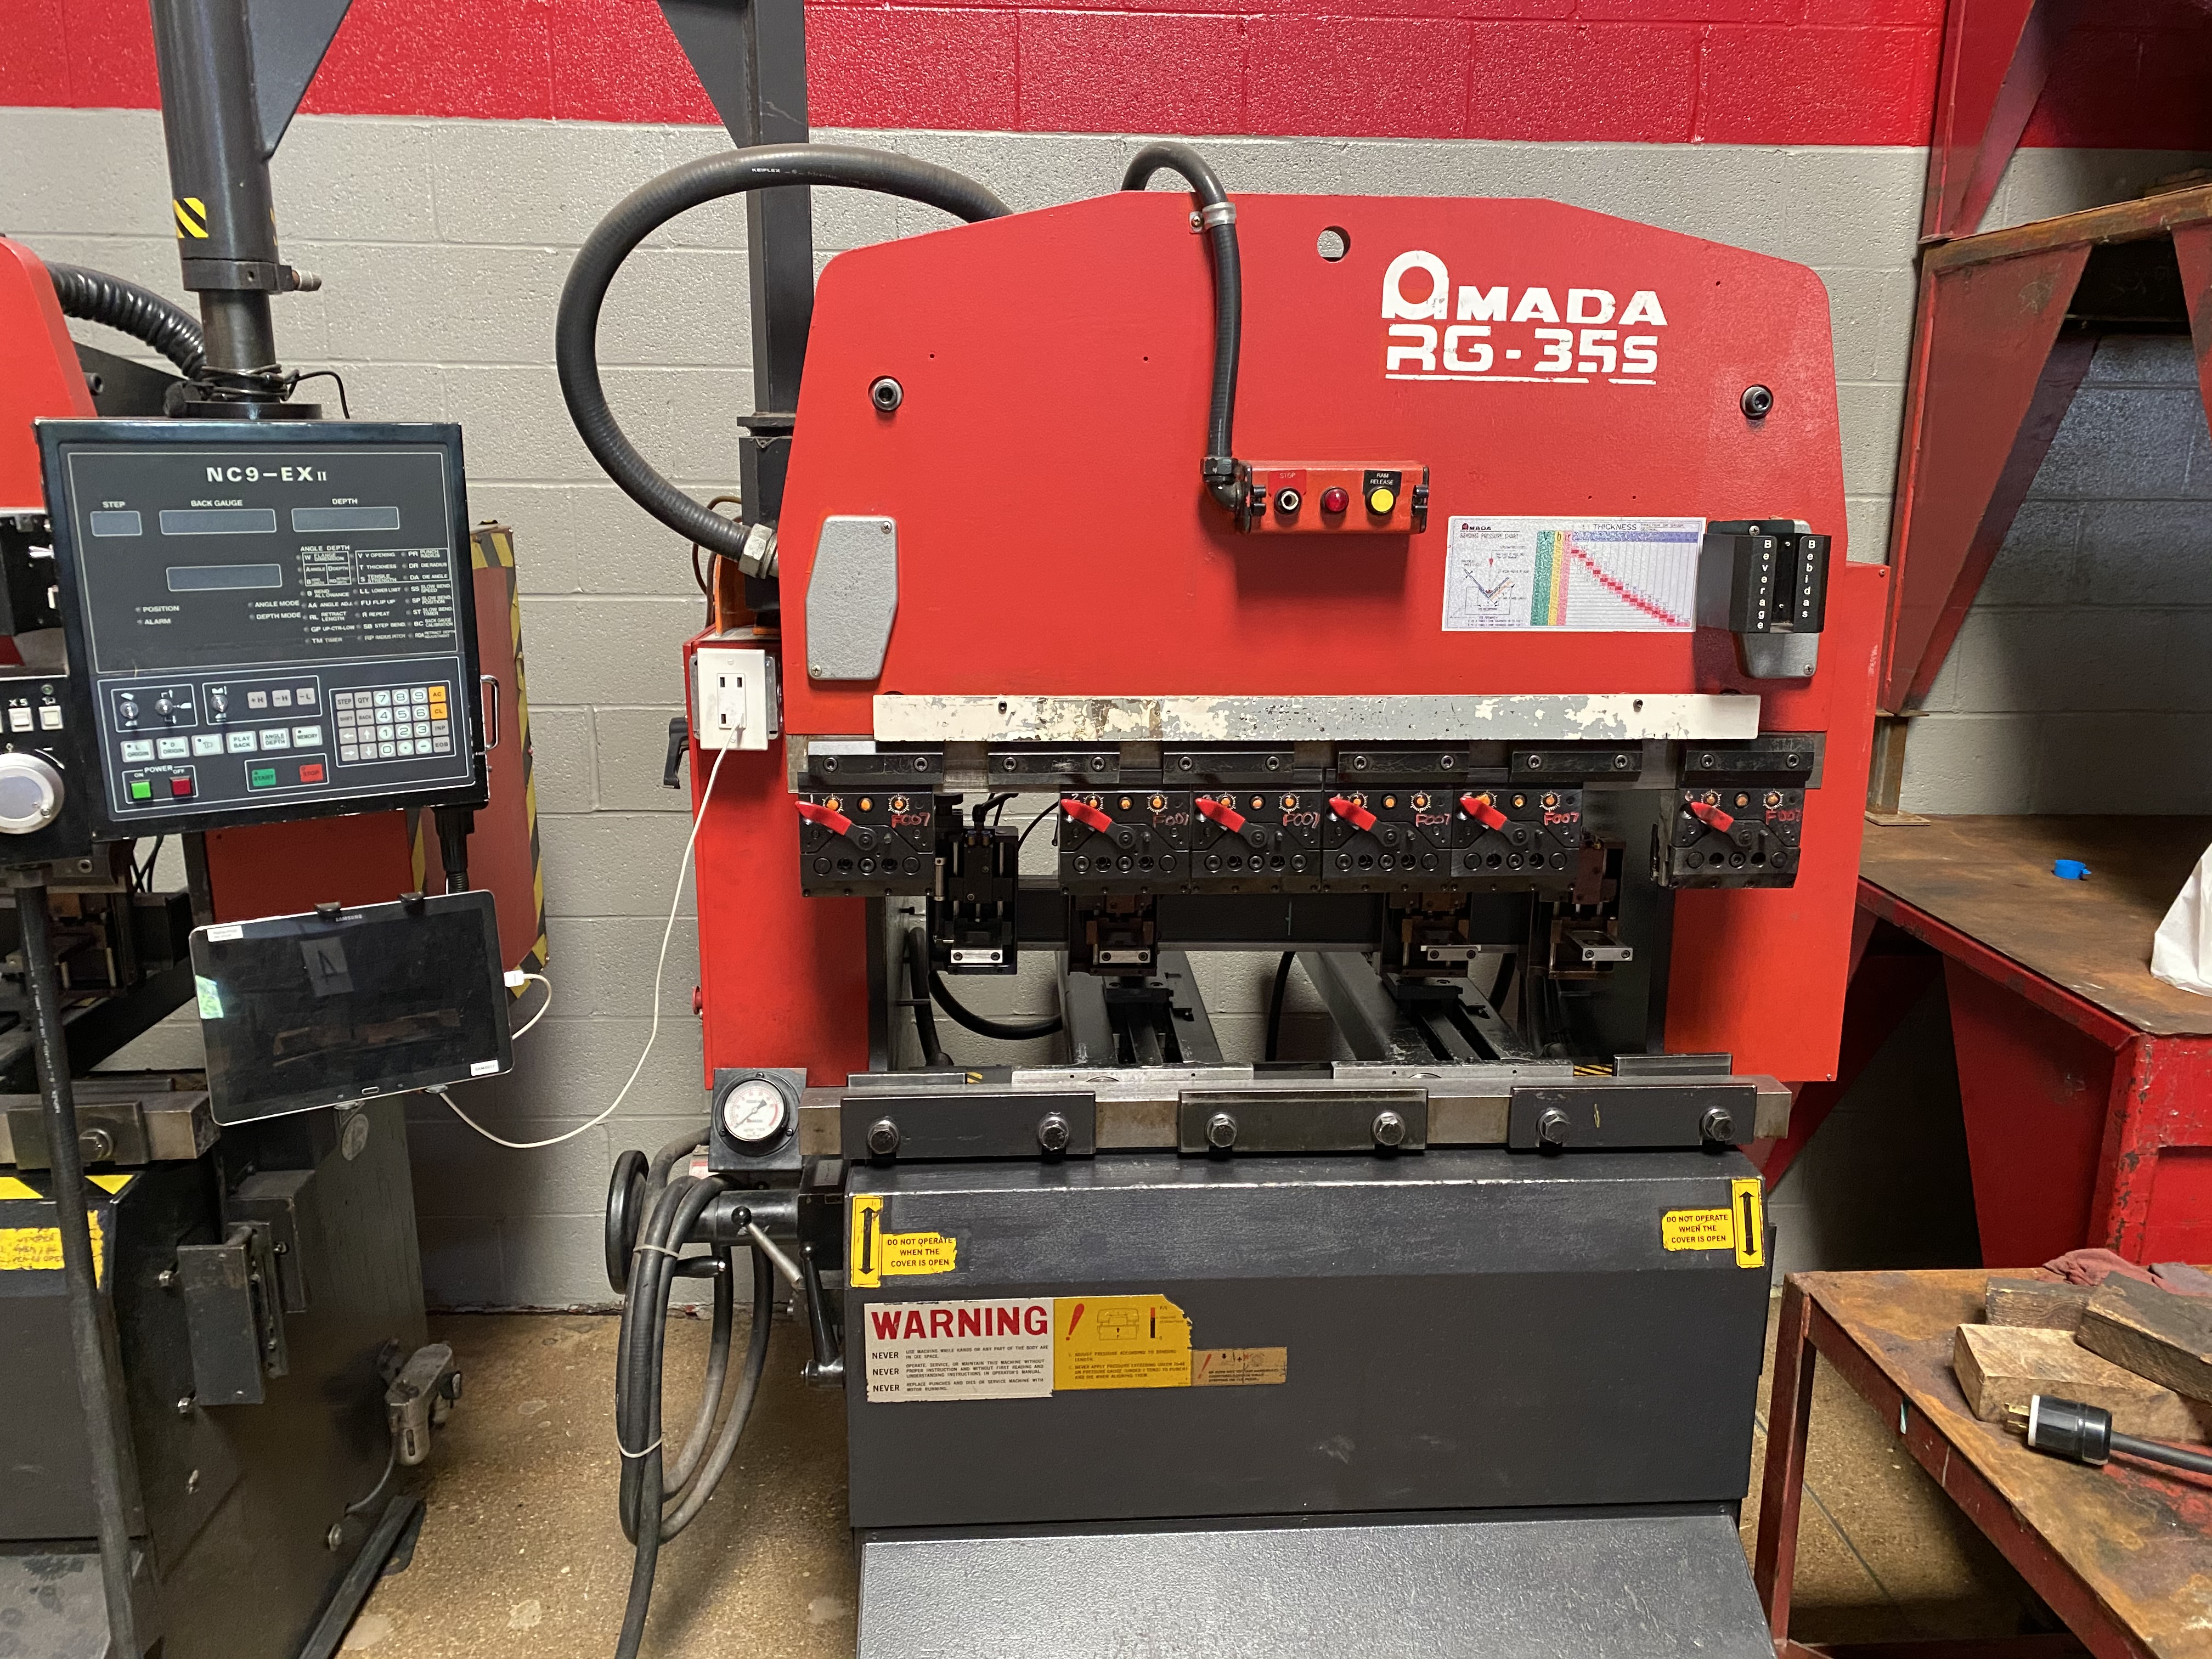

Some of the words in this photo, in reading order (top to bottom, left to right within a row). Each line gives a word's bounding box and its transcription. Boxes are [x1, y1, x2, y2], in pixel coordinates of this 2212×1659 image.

[1381, 250, 1668, 326] AMADA
[1757, 540, 1771, 629] Beverage
[1802, 540, 1816, 618] Bebidas
[379, 695, 386, 703] 7
[144, 765, 173, 774] POWER
[891, 812, 930, 828] F007
[1544, 811, 1579, 826] F007
[871, 1306, 1047, 1340] WARNING
